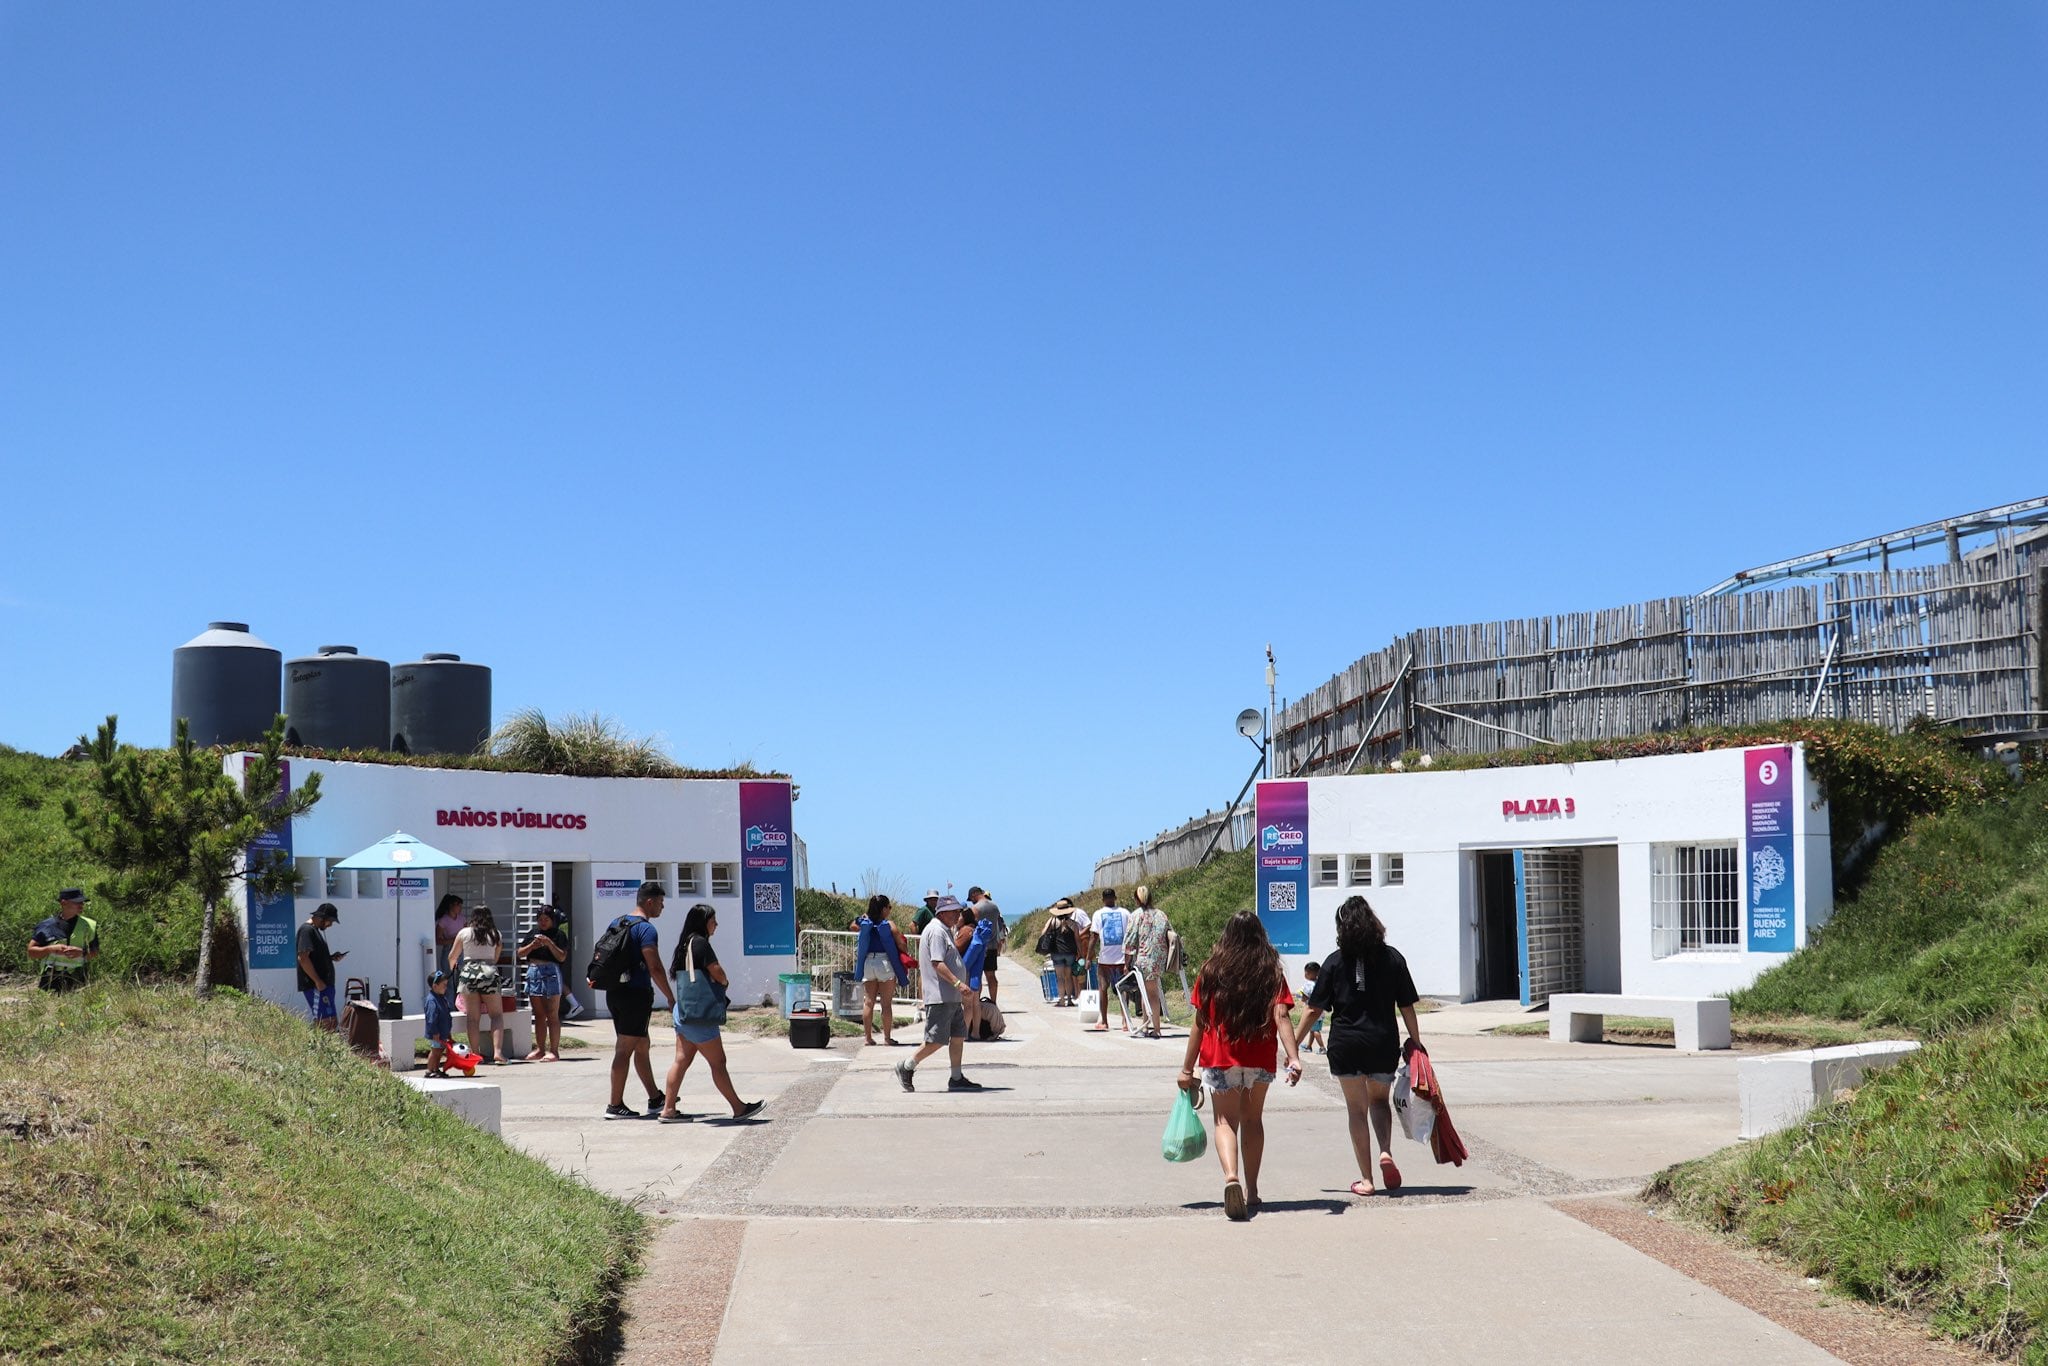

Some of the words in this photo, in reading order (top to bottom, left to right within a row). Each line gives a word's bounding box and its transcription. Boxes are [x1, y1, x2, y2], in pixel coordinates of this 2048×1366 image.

[1764, 765, 1773, 780] 3
[1503, 799, 1561, 815] PLAZA
[1565, 798, 1575, 813] 3
[437, 806, 497, 827] BAÑOS
[501, 808, 587, 830] PÚBLICOS
[1753, 919, 1787, 928] BUENOS
[1753, 929, 1776, 938] AIRES
[256, 935, 288, 945] BUENOS
[256, 945, 279, 955] AIRES
